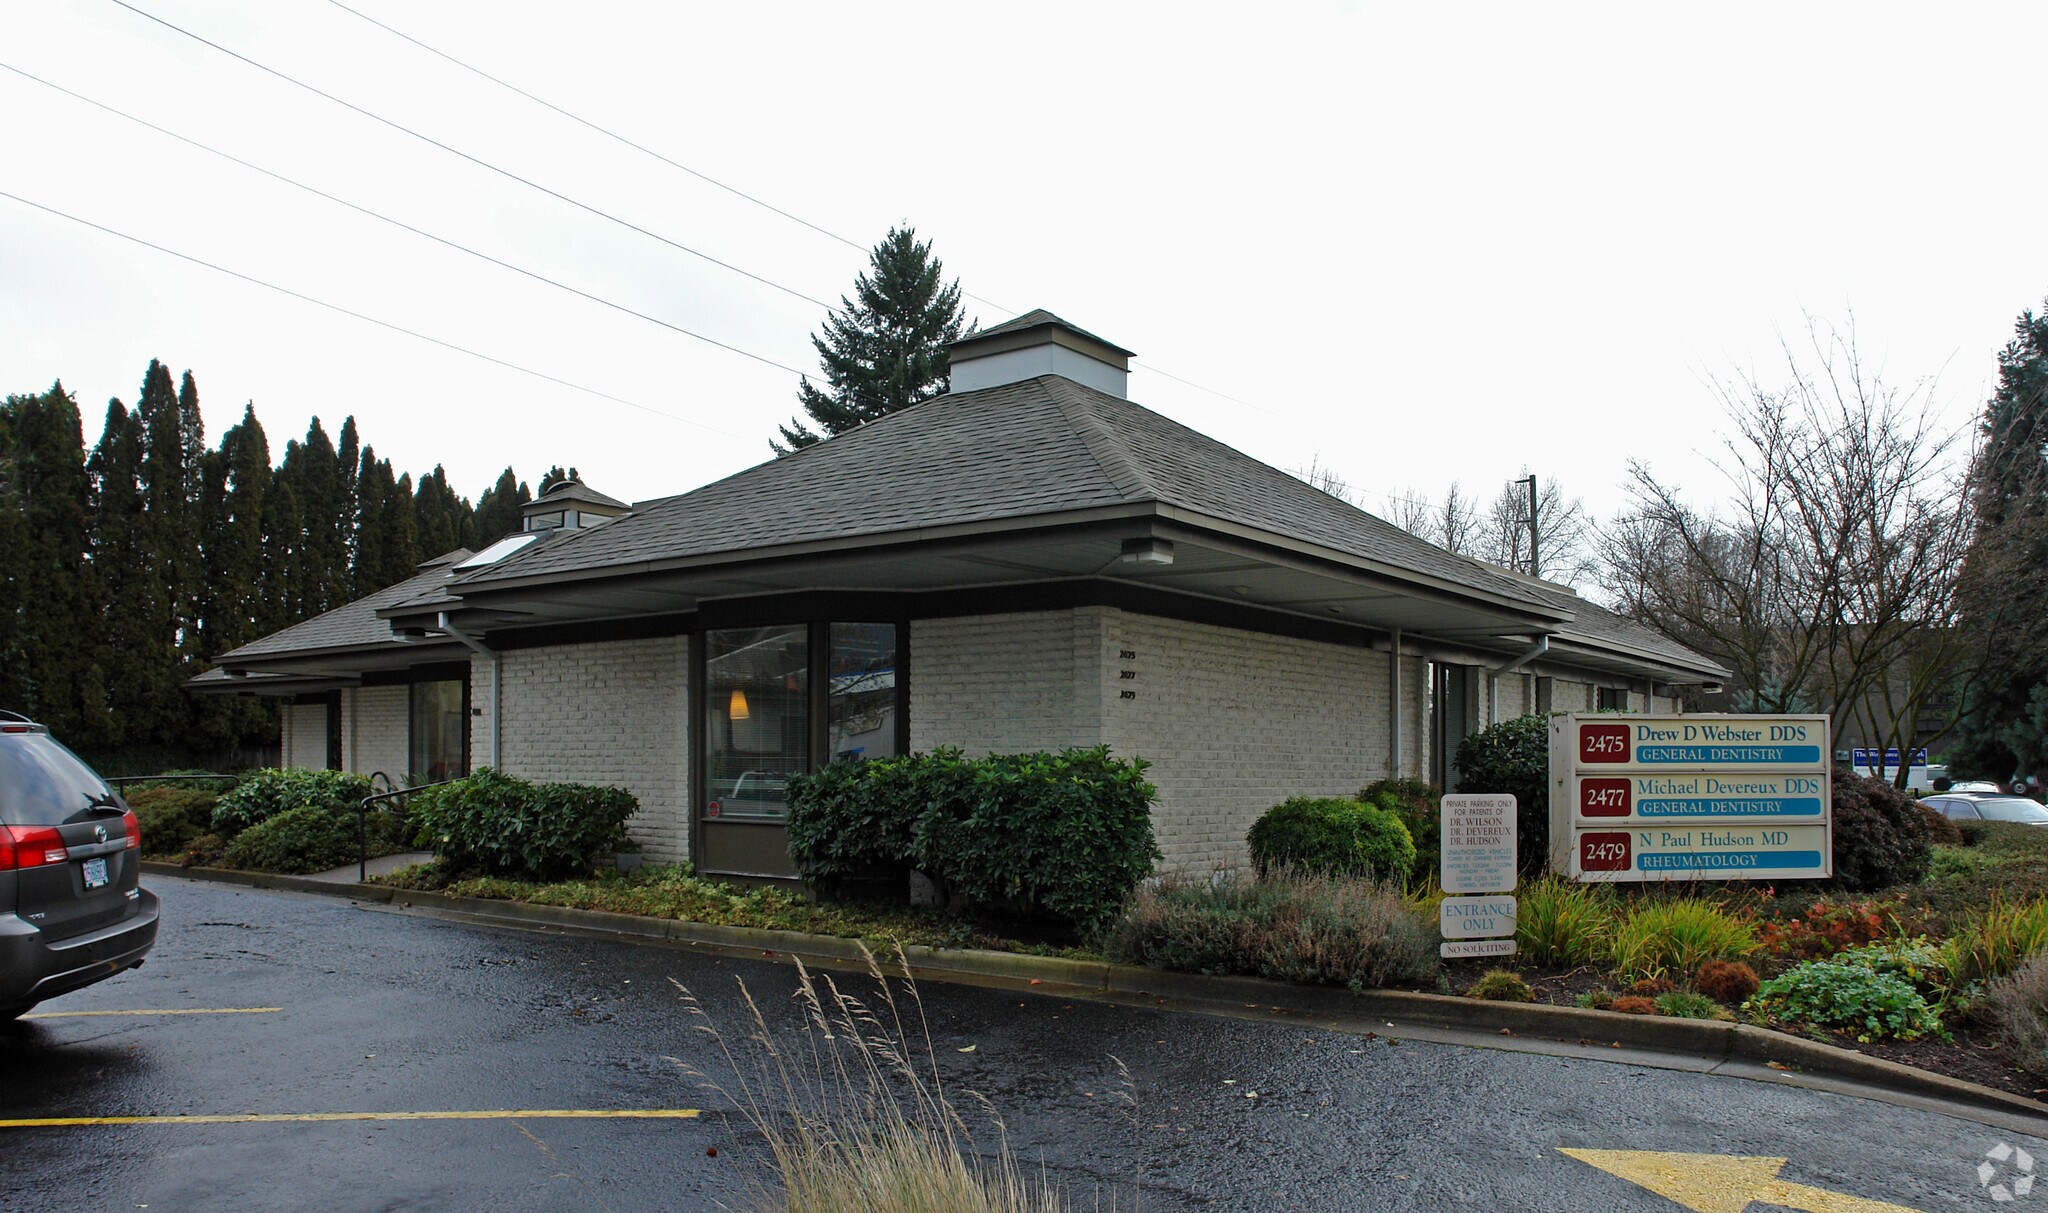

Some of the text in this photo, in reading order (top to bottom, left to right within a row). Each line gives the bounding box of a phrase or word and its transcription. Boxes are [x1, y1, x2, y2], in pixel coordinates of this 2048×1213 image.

[1637, 725, 1807, 742] Drew D Webster DDS
[1586, 735, 1624, 753] 2475
[1642, 748, 1784, 760] GENERAL DENTISTRY
[1637, 778, 1819, 795] Michael Devereux DDS
[1446, 800, 1467, 808] PRIVATE
[1470, 800, 1494, 808] PARKING
[1587, 789, 1625, 806] 2477
[1454, 808, 1466, 816] FOR
[1642, 801, 1782, 813] GENERAL DENTISTRY
[1450, 818, 1502, 826] DR. WILSON
[1450, 827, 1511, 836] DR. DEVEREUX
[1450, 837, 1501, 846] DR. HUDSON
[1640, 831, 1788, 847] N Paul Hudson MD
[1586, 843, 1625, 860] 2479
[1643, 854, 1758, 868] RHEUMATOLOGY
[1446, 903, 1513, 917] ENTRANCE
[1463, 918, 1496, 931] ONLY
[1448, 944, 1510, 954] NO SOLICITING
